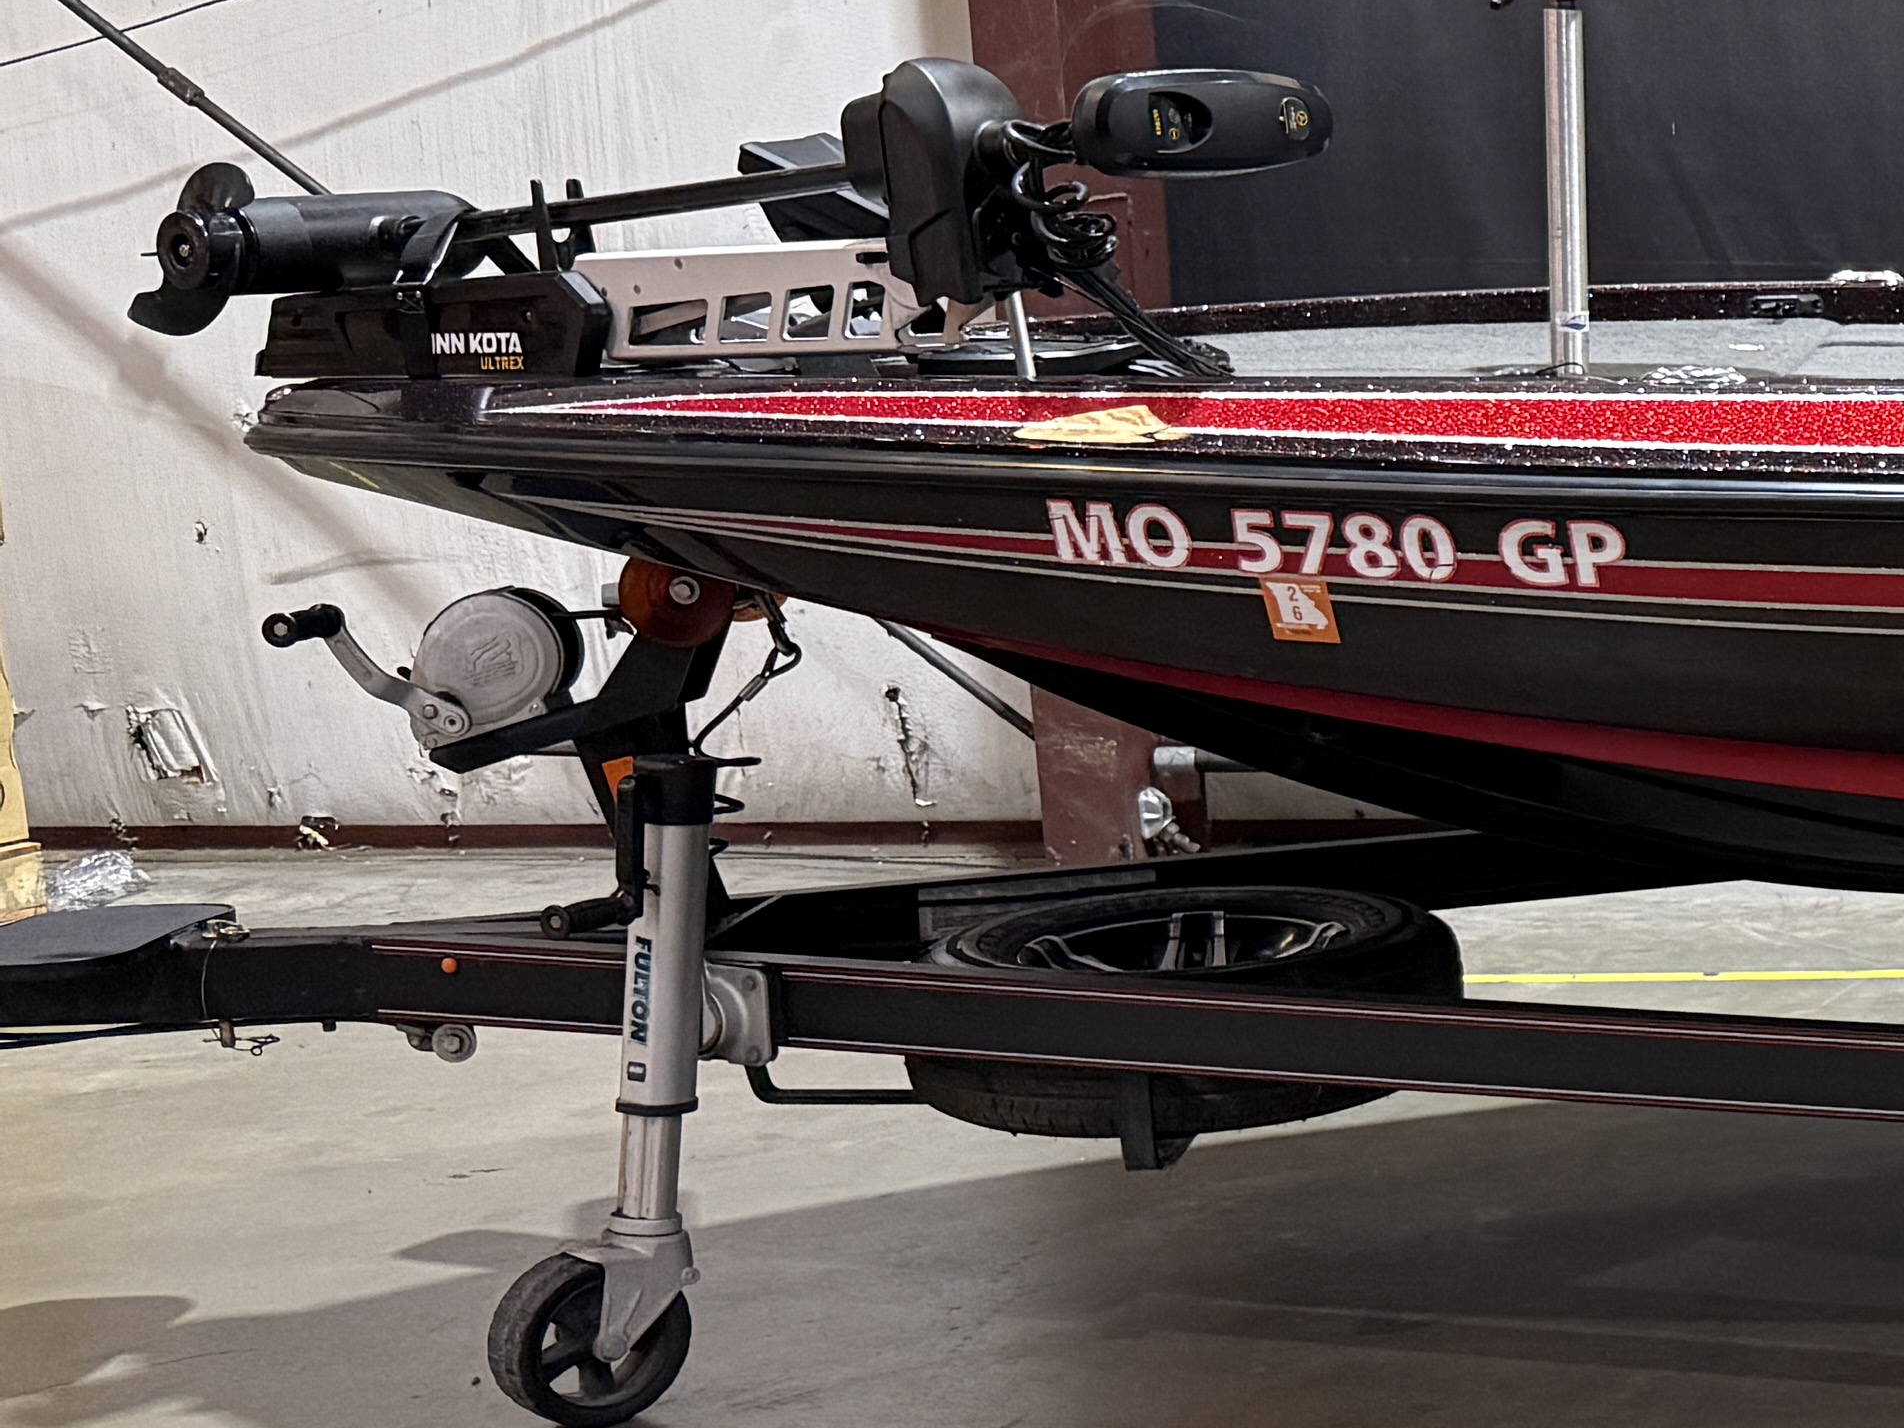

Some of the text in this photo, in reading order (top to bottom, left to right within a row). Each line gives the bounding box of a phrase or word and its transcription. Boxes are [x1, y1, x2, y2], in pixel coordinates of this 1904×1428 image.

[431, 332, 522, 354] INN KOTA
[480, 356, 524, 370] ULTREX
[1045, 498, 1627, 588] MO 5780 GP
[1286, 585, 1299, 602] 2
[628, 935, 653, 1046] FULTON
